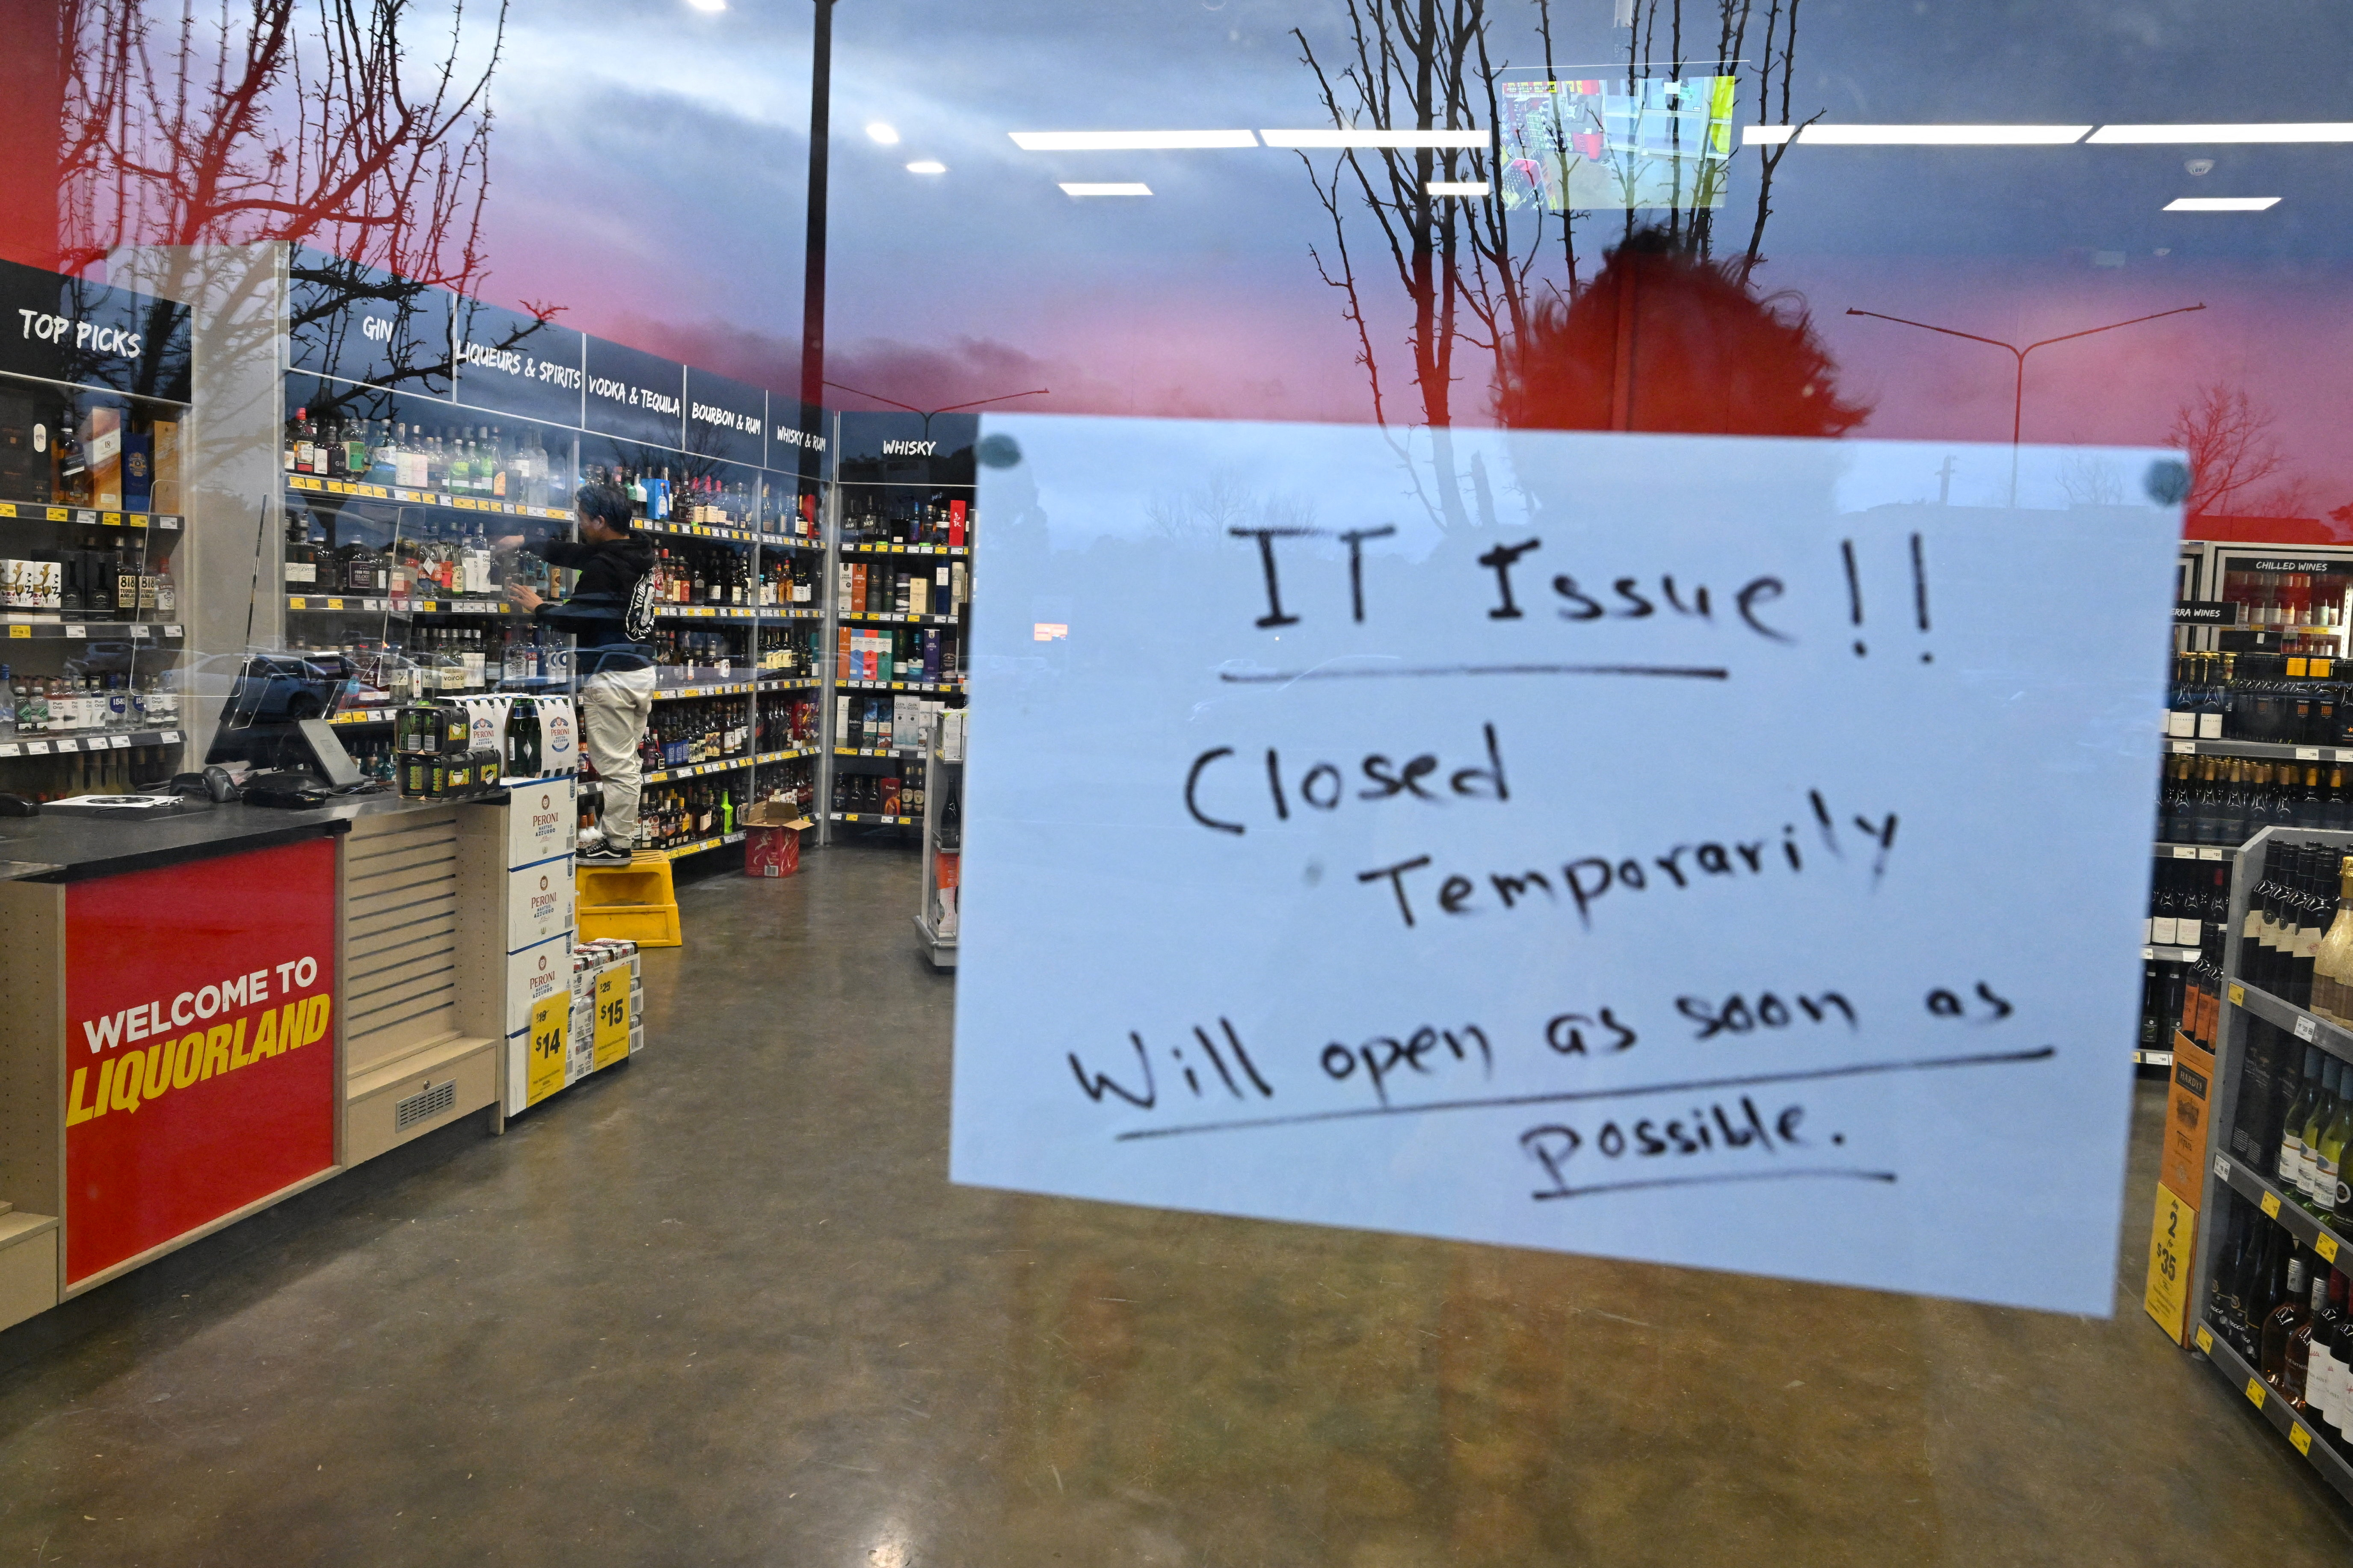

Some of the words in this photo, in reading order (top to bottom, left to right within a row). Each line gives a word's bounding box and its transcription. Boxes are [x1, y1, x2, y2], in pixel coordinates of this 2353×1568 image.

[19, 309, 69, 344] TOP
[77, 321, 141, 358] PICKS
[363, 316, 393, 342] GIN
[457, 340, 521, 375] LIQUEURS
[525, 358, 536, 377] &
[540, 362, 581, 389] SPIRITS
[589, 375, 626, 404] VODKA
[629, 387, 638, 404] &
[641, 389, 680, 418] TEQUILA
[692, 402, 735, 427] BOURBON
[737, 415, 743, 430] &
[746, 416, 760, 435] RUM
[777, 425, 804, 447] WHISKY
[805, 434, 811, 447] &
[813, 436, 826, 452] RUM
[883, 440, 936, 456] WHISKY
[2256, 561, 2295, 571] CHILLED
[2298, 562, 2328, 571] WINES
[120, 576, 134, 588] 818
[142, 577, 154, 588] 818
[1230, 527, 1394, 629] IT
[1479, 537, 1786, 637] Issue
[2170, 608, 2191, 617] ERRA
[2194, 609, 2221, 618] WINES
[474, 730, 494, 738] PERONI
[551, 728, 569, 737] PERONI
[1185, 724, 1509, 834] Closed
[533, 812, 559, 827] PERONI
[535, 828, 556, 837] AZZURRO
[1358, 789, 1900, 930] Temporarily
[531, 892, 557, 909] PERONI
[534, 908, 554, 918] AZZURRO
[530, 971, 555, 989] PERONI
[533, 987, 553, 999] AZZURRO
[536, 984, 550, 992] NASTRO
[83, 969, 268, 1053] WELCOME
[276, 956, 317, 993] TO
[601, 998, 623, 1027] $15
[535, 1028, 561, 1059] $14
[1069, 1017, 1274, 1109] Will
[1321, 1024, 1493, 1108] open
[1546, 1007, 1637, 1056] as
[1675, 988, 1858, 1039] soon
[1926, 981, 2014, 1021] as
[66, 994, 330, 1127] LIQUORLAND
[2180, 1071, 2202, 1090] HARDYS
[1521, 1097, 1845, 1189] possible.
[2168, 1211, 2178, 1239] 2
[2157, 1242, 2176, 1281] $35
